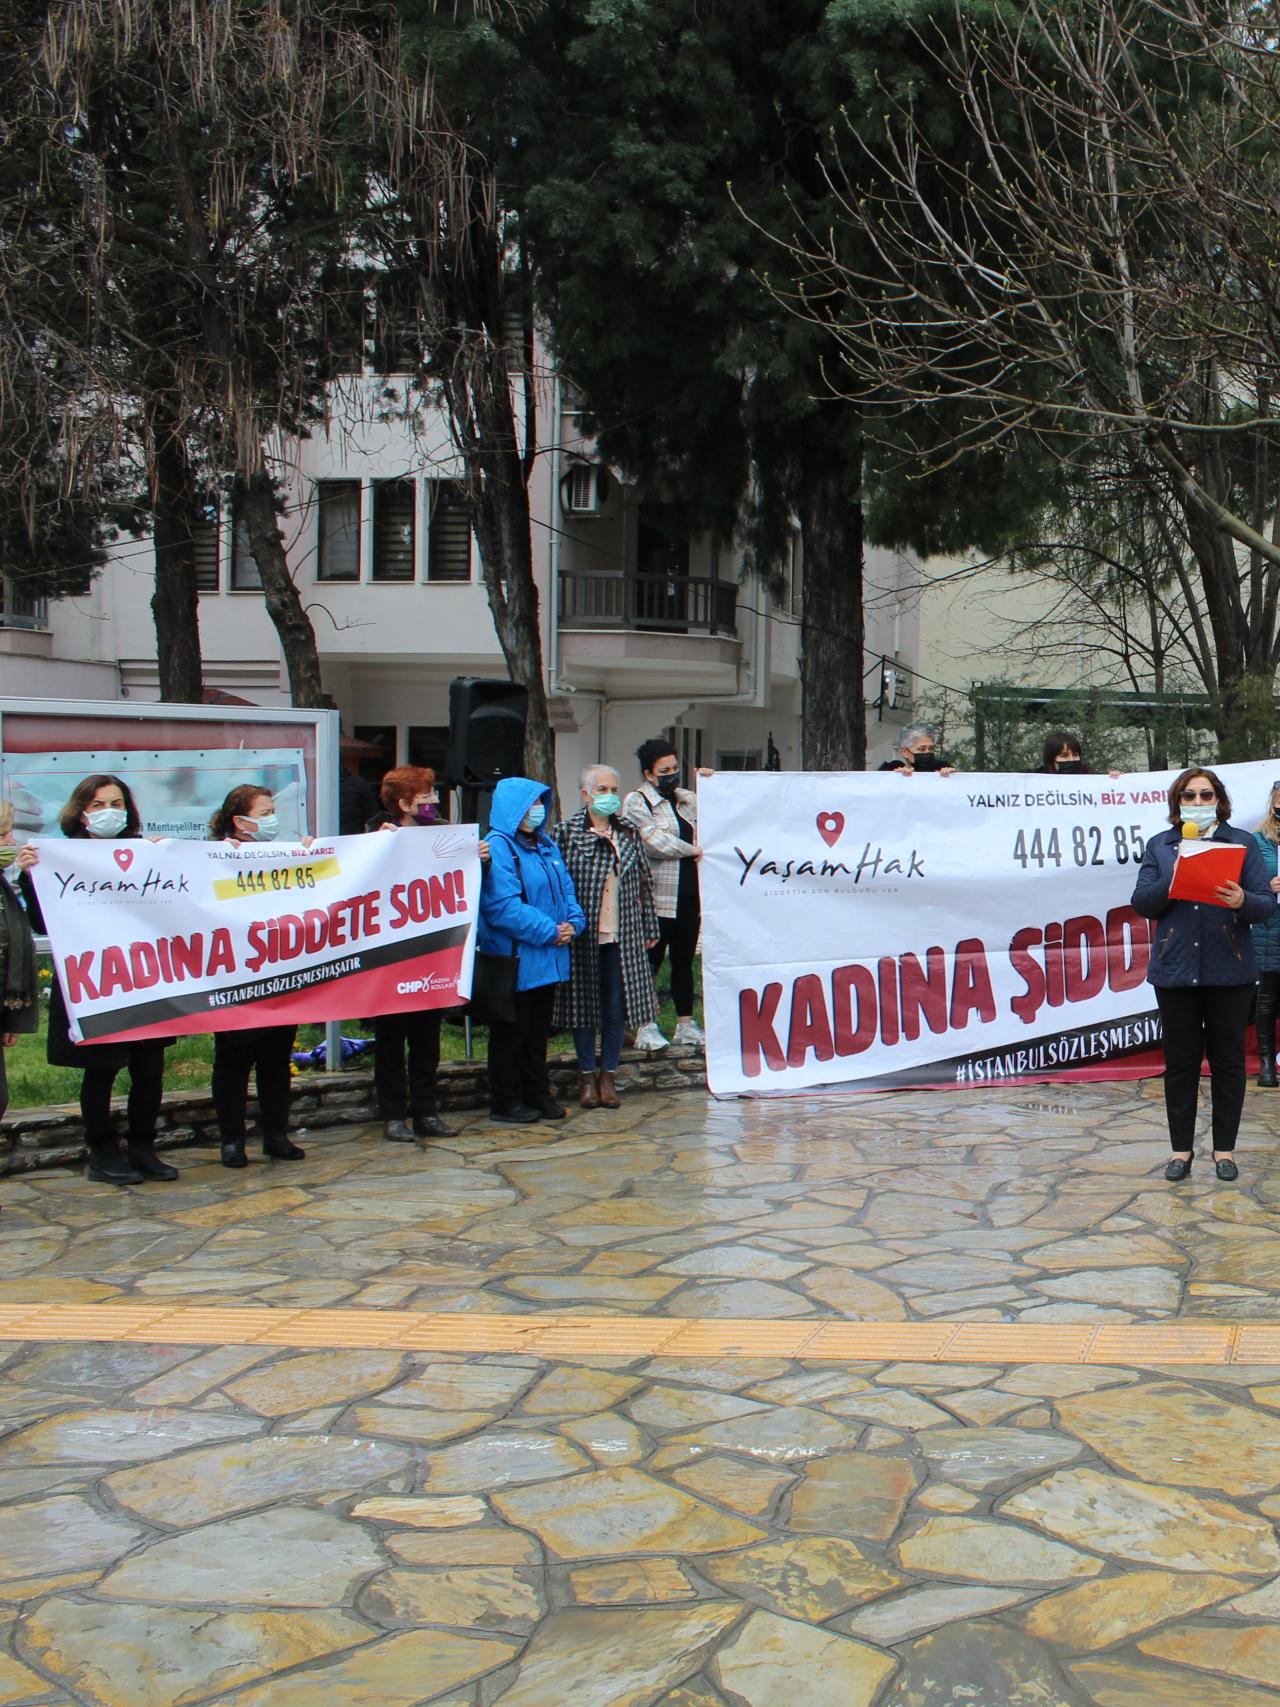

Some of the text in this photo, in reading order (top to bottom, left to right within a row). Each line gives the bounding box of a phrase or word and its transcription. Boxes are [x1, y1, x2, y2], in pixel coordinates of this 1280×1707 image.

[967, 789, 1169, 807] YALNIZ DEĞİLSİN, BİZ VARI
[147, 821, 205, 834] Menteşeliler;
[207, 851, 242, 859] YALNIZ
[244, 849, 290, 859] DEĞİLSİN,
[291, 849, 307, 857] BİZ
[1013, 825, 1145, 869] 444 82 85
[237, 867, 316, 892] 444 82 85
[63, 869, 468, 1004] KADINA ŞİDDETE SON!
[208, 957, 362, 1007] #İSTANBULSÖZLEŞMESİYAŞATIR
[396, 980, 423, 994] CHP
[738, 904, 1157, 1078] KADINA ŞİDD
[955, 1017, 1163, 1082] #İSTANBULSÖZLEŞMESİY
